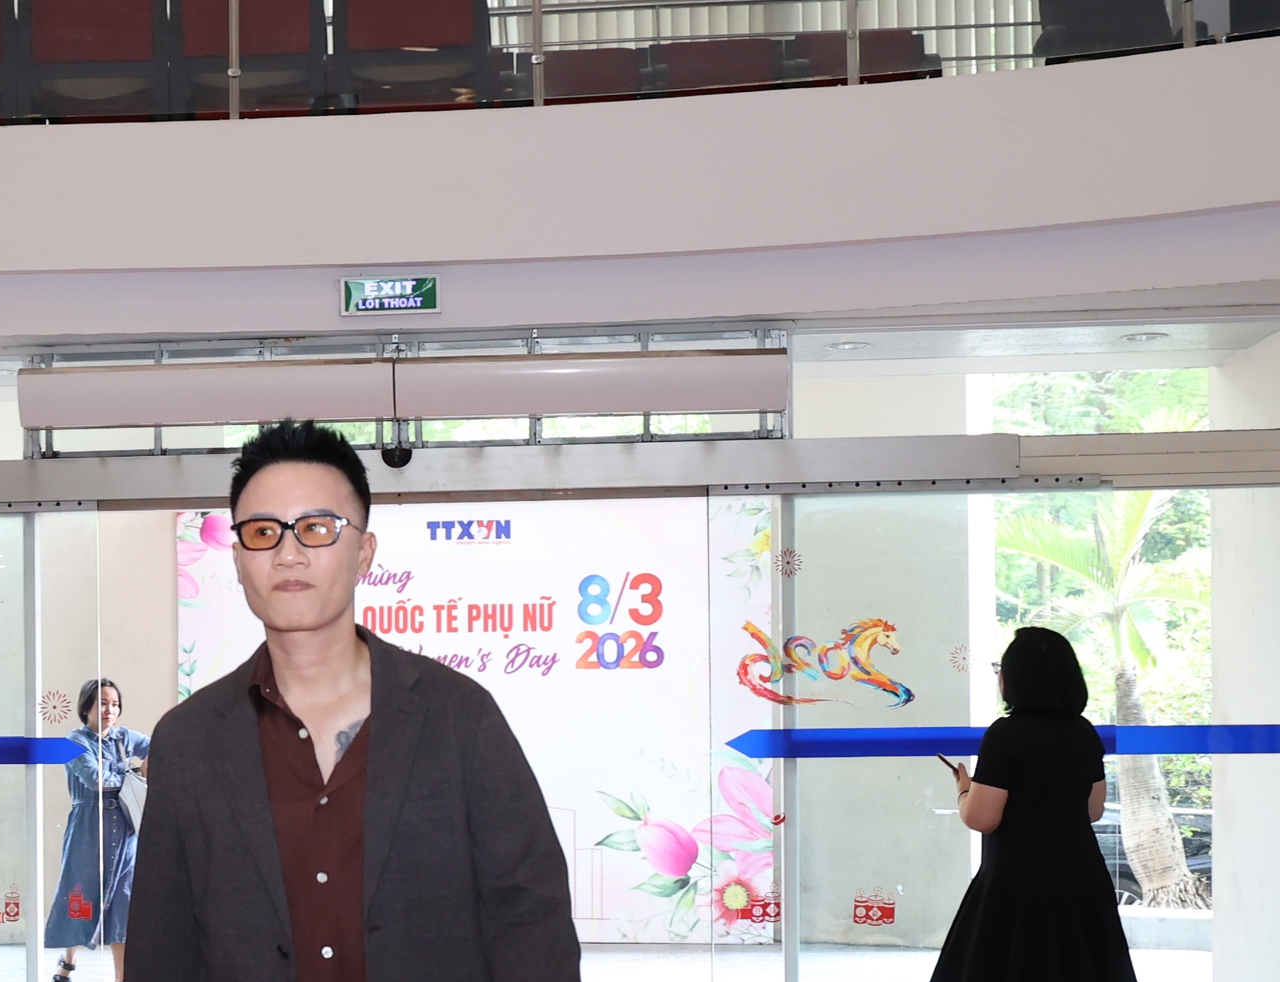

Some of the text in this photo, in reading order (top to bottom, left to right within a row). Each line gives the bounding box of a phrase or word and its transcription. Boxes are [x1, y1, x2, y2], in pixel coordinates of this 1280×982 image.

[364, 281, 417, 295] EXIT
[382, 295, 423, 308] THOÁT
[426, 520, 511, 540] TTXVN
[577, 571, 664, 626] 8/3
[363, 595, 556, 638] QUỐC TẾ PHỤ NỮ
[504, 643, 560, 676] Day
[575, 630, 665, 670] 2026
